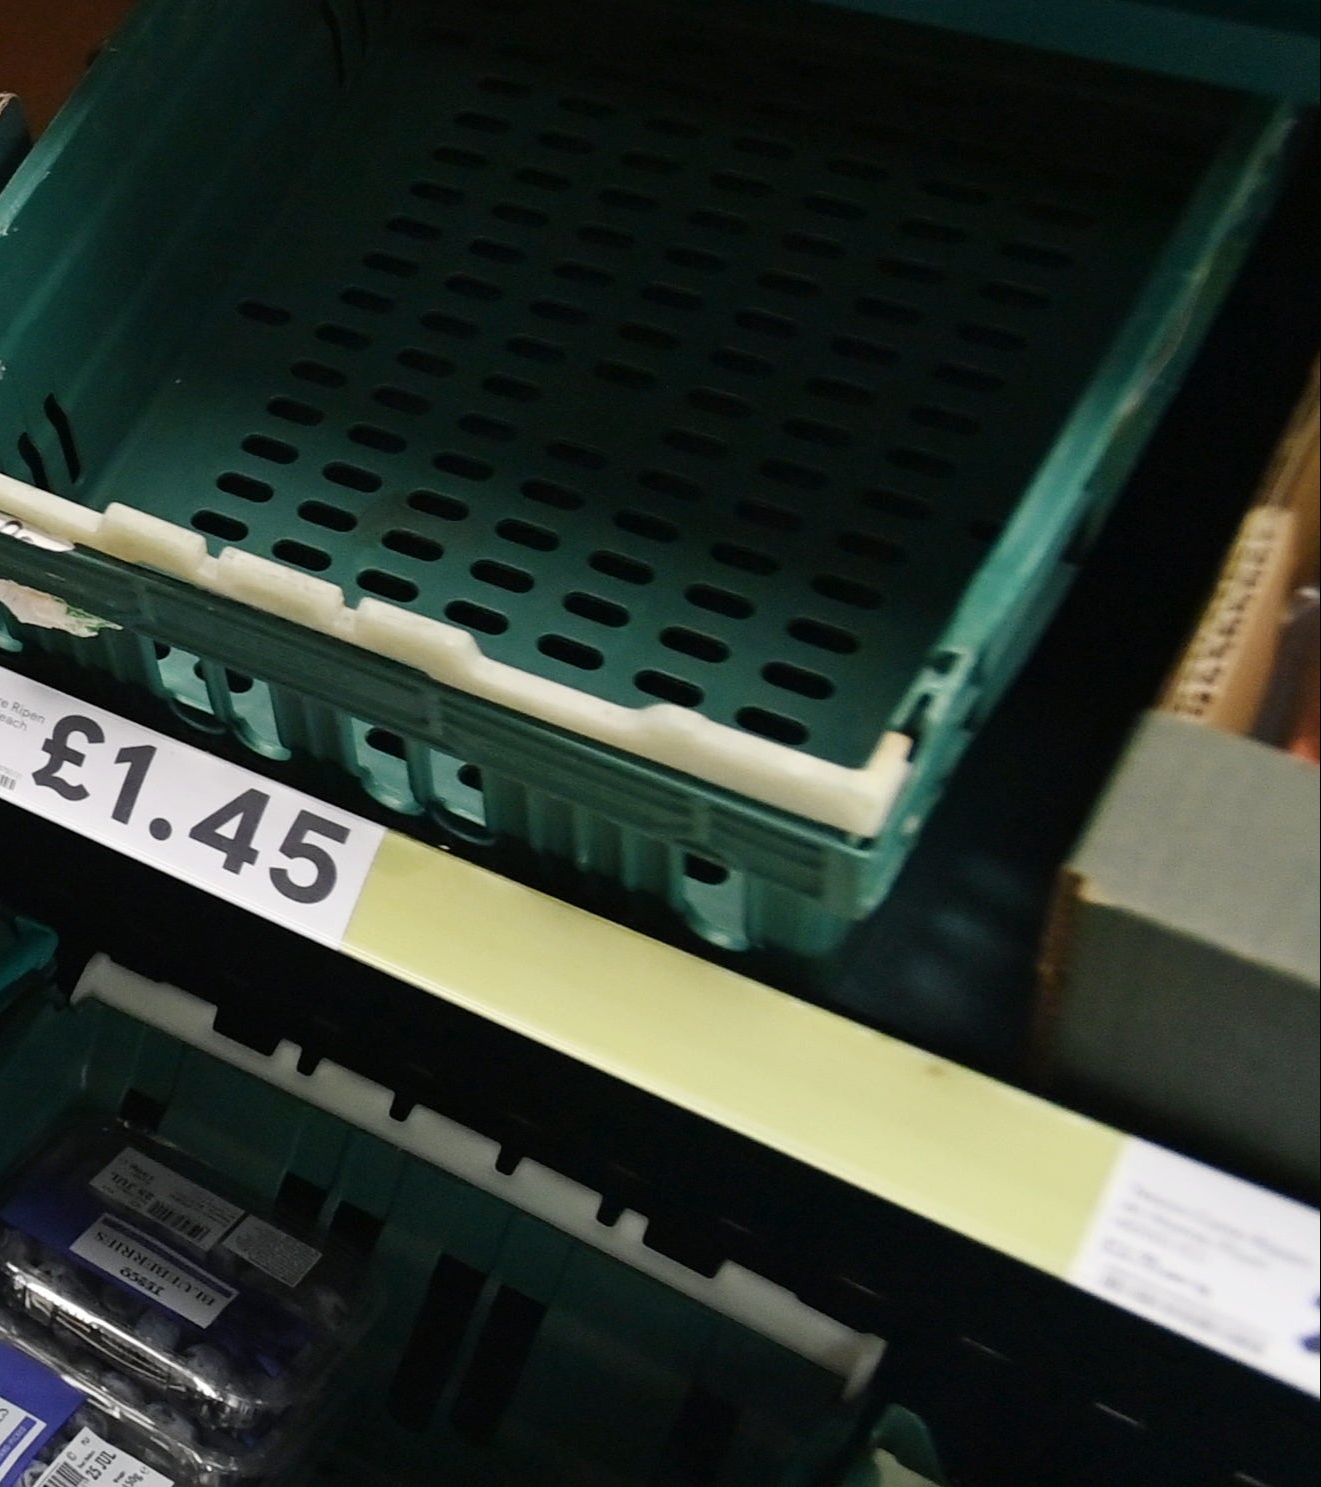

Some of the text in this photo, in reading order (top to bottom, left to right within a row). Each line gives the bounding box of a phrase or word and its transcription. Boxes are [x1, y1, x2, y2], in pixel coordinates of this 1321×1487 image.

[10, 701, 47, 725] Ripen
[30, 713, 353, 906] £1.45
[95, 1229, 217, 1308] BLUEBERRIES
[118, 1266, 169, 1296] TESCO
[84, 1464, 102, 1482] 25
[97, 1450, 119, 1473] JUL
